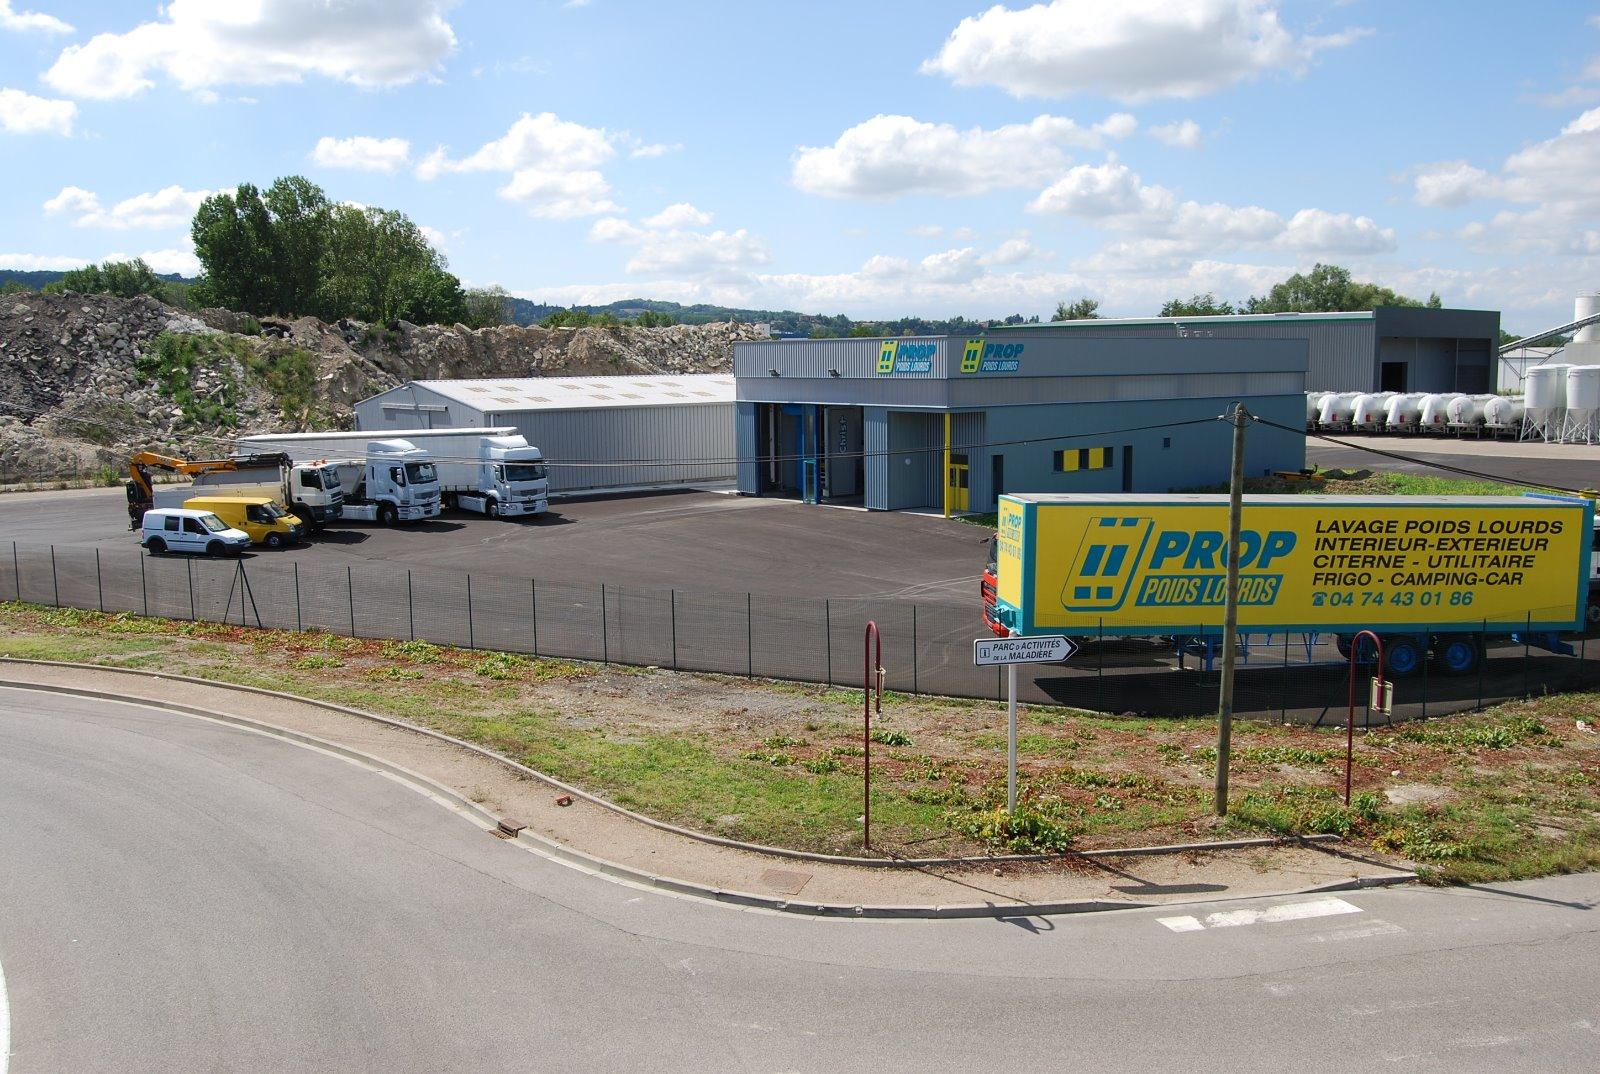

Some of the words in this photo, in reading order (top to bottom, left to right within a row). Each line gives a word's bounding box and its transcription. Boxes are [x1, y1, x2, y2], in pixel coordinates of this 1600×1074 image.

[984, 343, 1024, 358] PROP
[1315, 520, 1398, 534] LAVAGE
[1405, 520, 1471, 534] POIDS
[1478, 520, 1563, 534] LOURDS
[1149, 530, 1297, 569] PROP
[1314, 538, 1549, 551] INTERIEUR-EXTERIEUR
[1313, 555, 1406, 569] CITERNE
[1428, 555, 1535, 568] UTILITAIRE
[1312, 572, 1372, 586] FRIGO
[1390, 572, 1523, 586] CAMPING-CAR
[1142, 577, 1200, 603] POIDS
[1202, 577, 1277, 602] LORDS
[1330, 592, 1354, 606] 04
[1361, 592, 1384, 606] 74
[1390, 592, 1414, 606] 43
[1421, 592, 1442, 606] 01
[1450, 592, 1473, 606] 86
[993, 643, 1014, 651] PARC
[1009, 649, 1053, 660] MALADIÈRE
